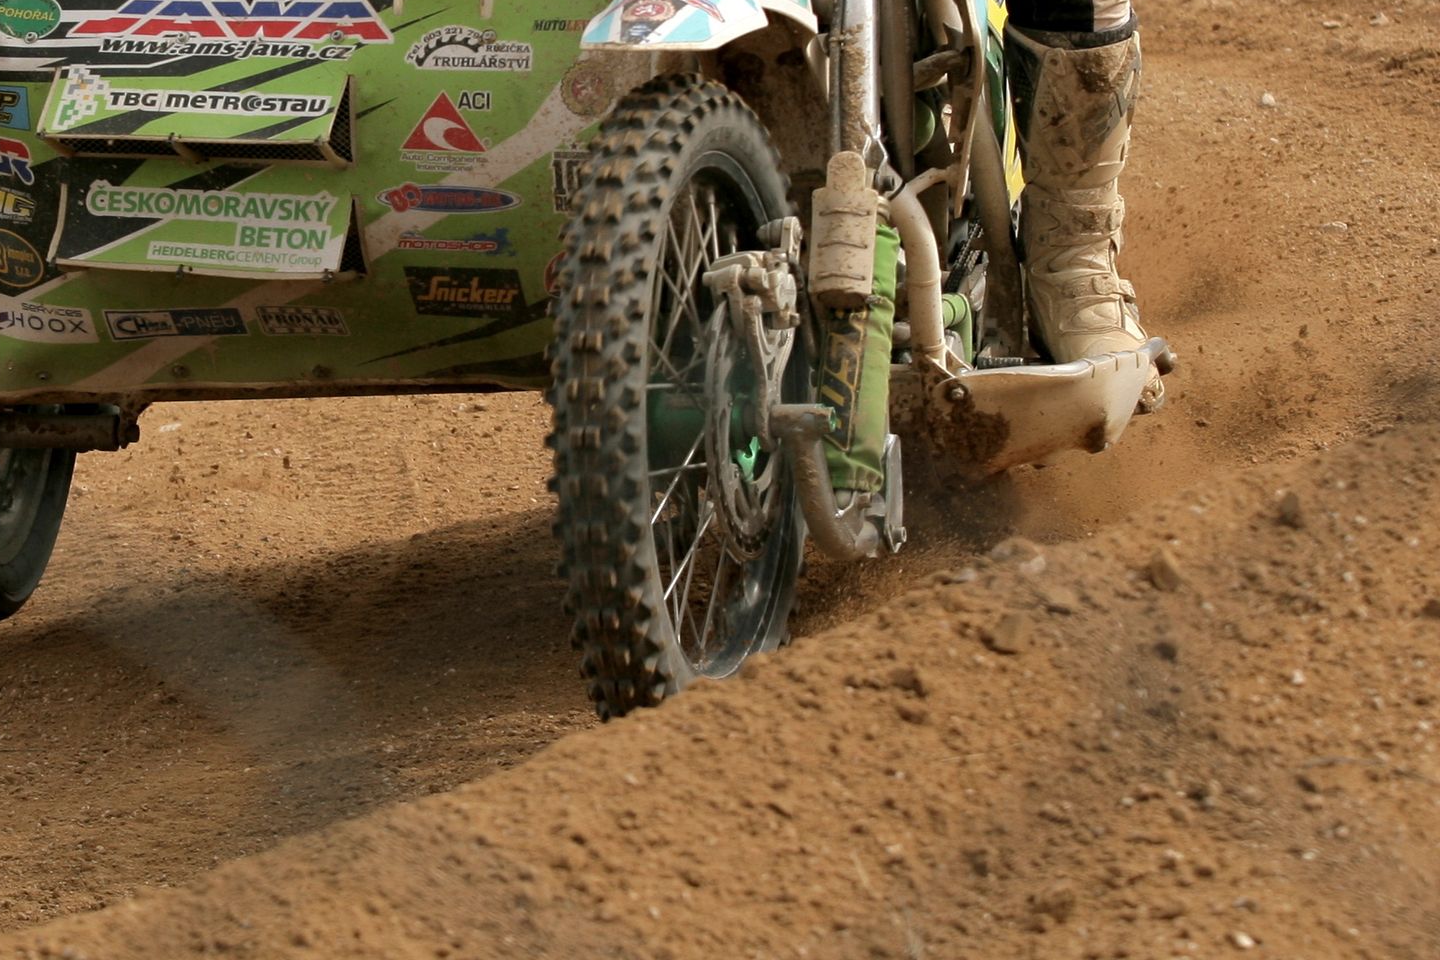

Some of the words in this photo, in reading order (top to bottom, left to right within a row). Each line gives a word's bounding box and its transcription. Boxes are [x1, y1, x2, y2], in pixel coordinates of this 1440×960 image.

[101, 37, 354, 59] www.ams-jawa.cz
[432, 53, 531, 69] TRUHLÁŘSTVÍ
[109, 91, 158, 106] TBG
[459, 92, 491, 110] ACI
[90, 185, 331, 222] ČESKOMORAVSKÝ
[240, 225, 327, 251] BETON
[151, 244, 286, 264] HEIDELBERGCEMENT
[288, 254, 323, 267] Group
[417, 275, 519, 304] Snickers
